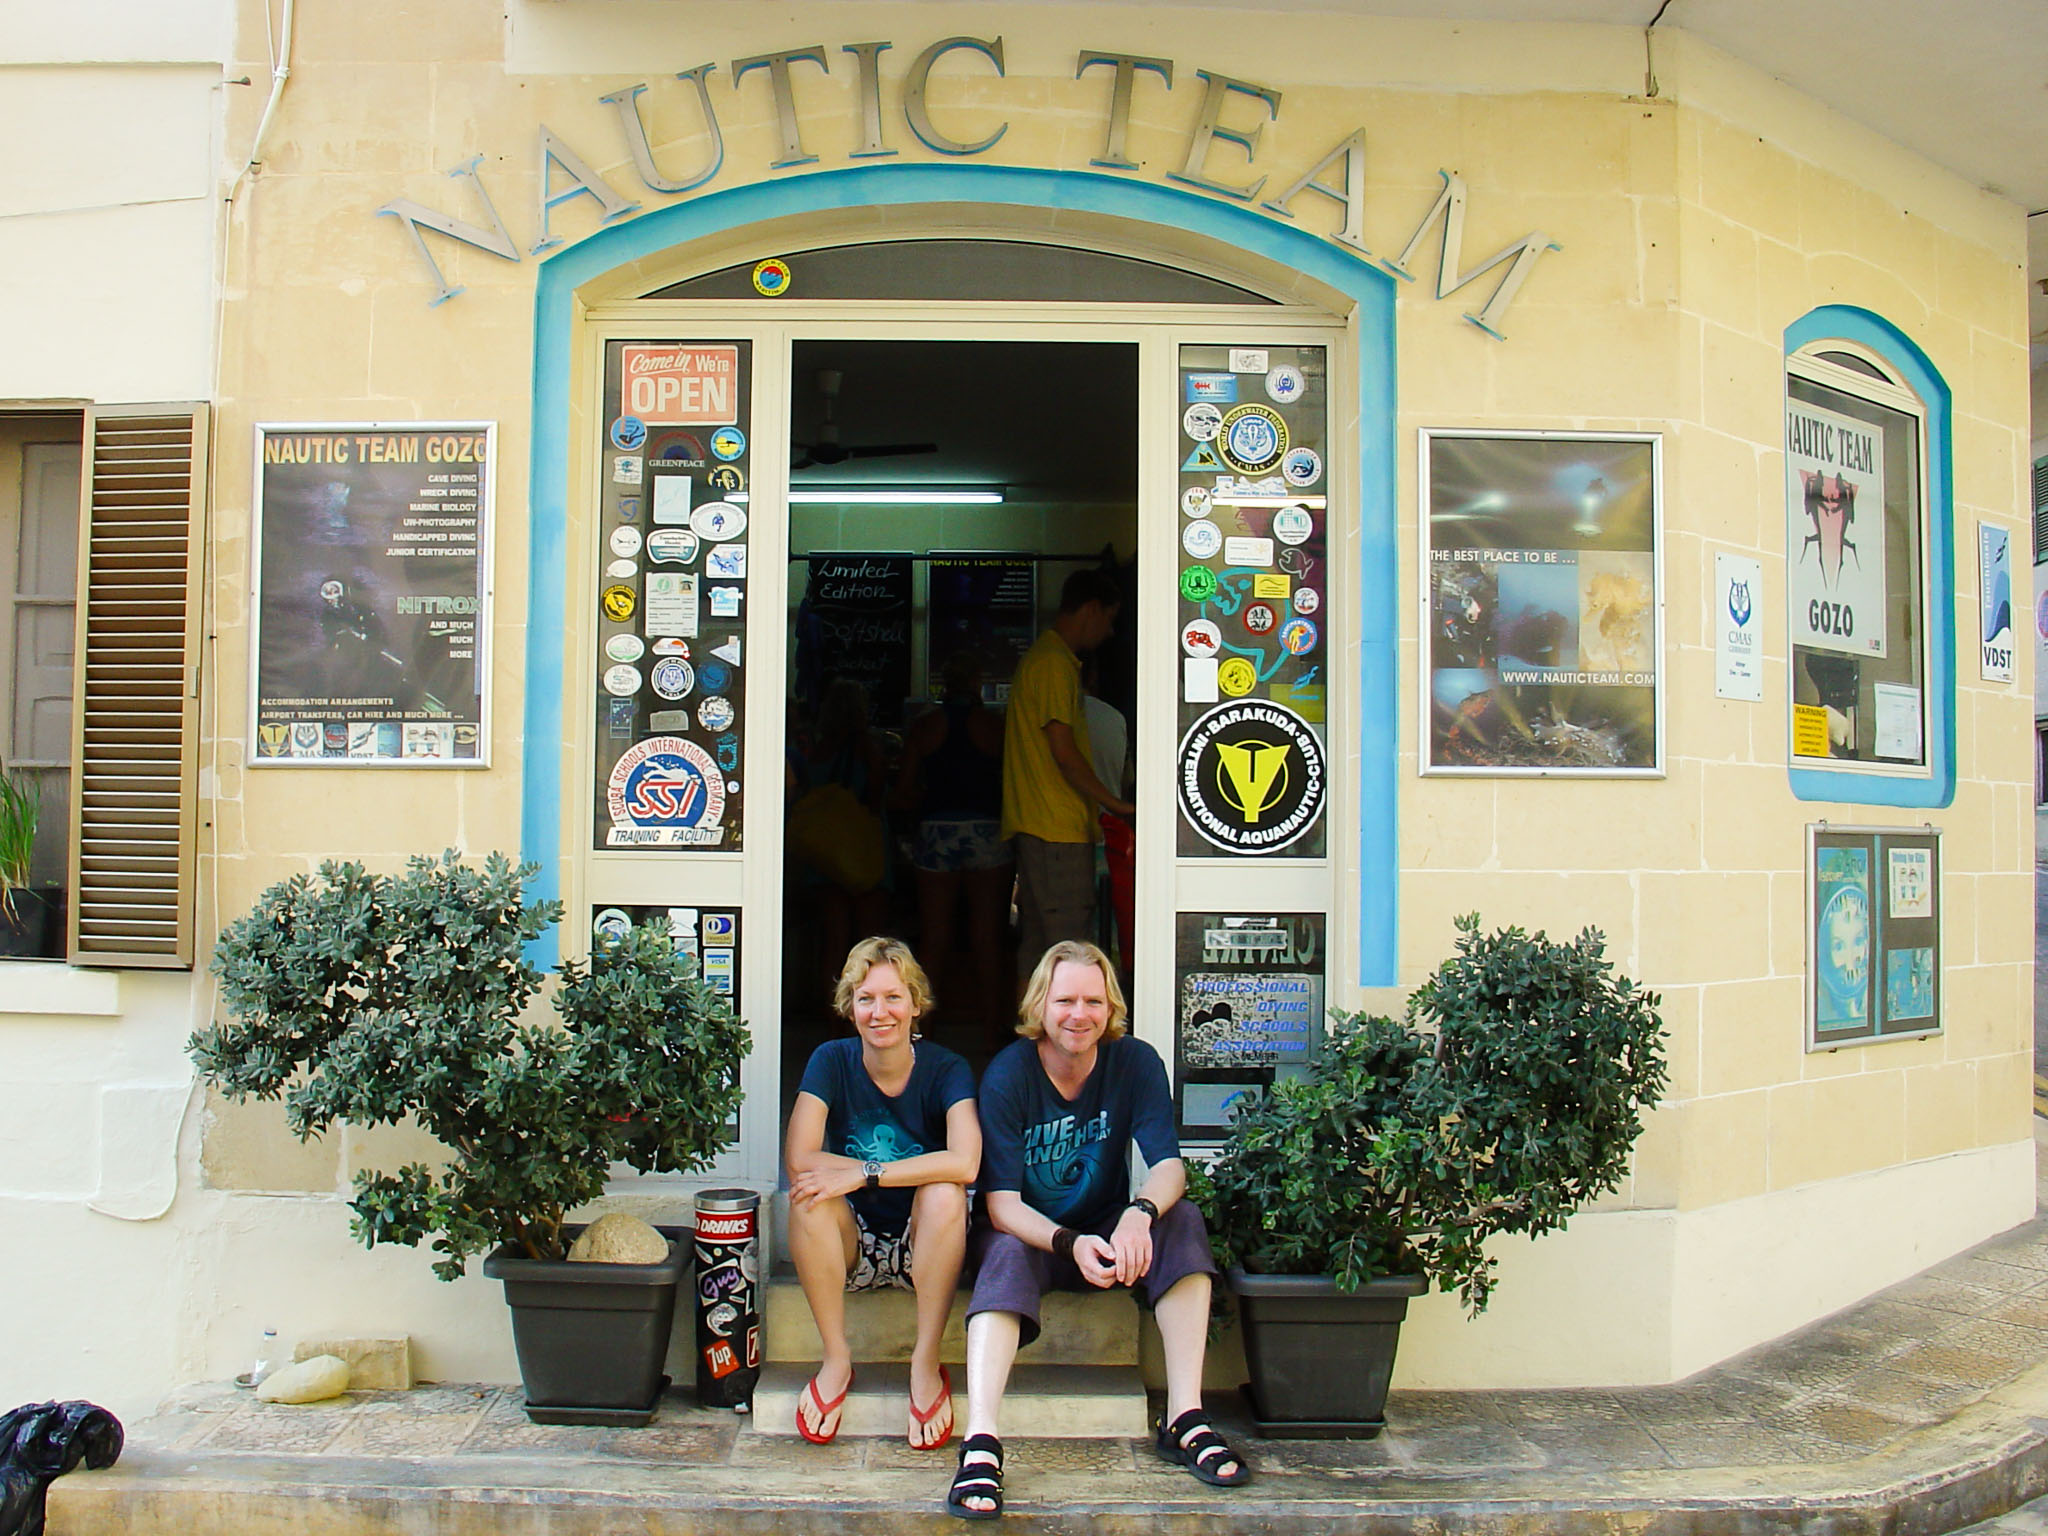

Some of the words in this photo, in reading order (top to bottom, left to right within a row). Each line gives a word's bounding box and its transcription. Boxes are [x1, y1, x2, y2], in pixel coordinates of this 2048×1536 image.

[375, 35, 1008, 308] NAUTIC
[1076, 49, 1564, 342] TEAM
[630, 354, 673, 374] Come
[674, 351, 691, 374] in
[696, 355, 729, 373] We're
[631, 376, 727, 413] OPEN
[264, 437, 349, 464] NAUTIC
[356, 436, 418, 463] TEAM
[1837, 428, 1874, 475] TEAM
[649, 459, 705, 468] GREENPEACE
[1237, 462, 1265, 472] CMAS
[428, 474, 449, 483] CAVE
[450, 474, 477, 483] DIVING
[420, 489, 448, 497] WRECK
[449, 489, 477, 497] DIVING
[409, 503, 440, 512] MARINE
[441, 503, 477, 512] BIOLOGY
[403, 518, 477, 527] UW-PHOTOGRAPHY
[392, 533, 448, 541] HANDICAPPED
[449, 533, 476, 541] DIVING
[385, 548, 416, 556] JUNIOR
[417, 548, 476, 556] CERTIFICATION
[1430, 550, 1449, 561] THE
[1454, 550, 1479, 562] BEST
[1484, 551, 1519, 562] PLACE
[1524, 551, 1540, 562] TO
[1544, 552, 1558, 563] BE
[817, 558, 899, 580] Limited
[819, 582, 896, 600] Edition
[397, 596, 482, 615] NITROX
[1808, 598, 1854, 638] GOZO
[430, 621, 448, 629] AND
[449, 621, 474, 630] MUCH
[449, 635, 474, 644] MUCH
[1728, 631, 1752, 646] CMAS
[449, 650, 473, 659] MORE
[1983, 646, 2012, 669] VDST
[1503, 671, 1654, 685] WWW.NAUTICTEAM.COM
[261, 698, 329, 706] ACCOMMODATION
[330, 697, 394, 706] ARRANGEMENTS
[261, 711, 295, 719] AIRPORT
[297, 711, 345, 720] TRANSFERS,
[346, 711, 363, 719] CAR
[364, 711, 384, 719] HIRE
[386, 711, 402, 719] AND
[404, 711, 428, 719] MUCH
[429, 711, 452, 719] MORE
[1795, 706, 1827, 718] WARNING
[1207, 707, 1297, 737] BARAKUDA
[648, 738, 711, 773] INTERNATIONAL
[613, 745, 647, 783] SCHOOLS
[1184, 732, 1238, 843] INTERNATIONAL
[610, 787, 627, 817] SCUBA
[627, 779, 702, 820] SSI
[707, 773, 723, 819] GERMANY
[614, 830, 661, 842] TRAINING
[671, 830, 718, 842] FACILITY
[1194, 981, 1308, 993] PROFESSIONAL
[1257, 1001, 1308, 1012] DIVING
[1240, 1021, 1308, 1032] SCHOOLS
[1212, 1040, 1307, 1052] ASSOCIATION
[700, 1218, 749, 1235] DRINKS
[706, 1346, 732, 1373] 7up
